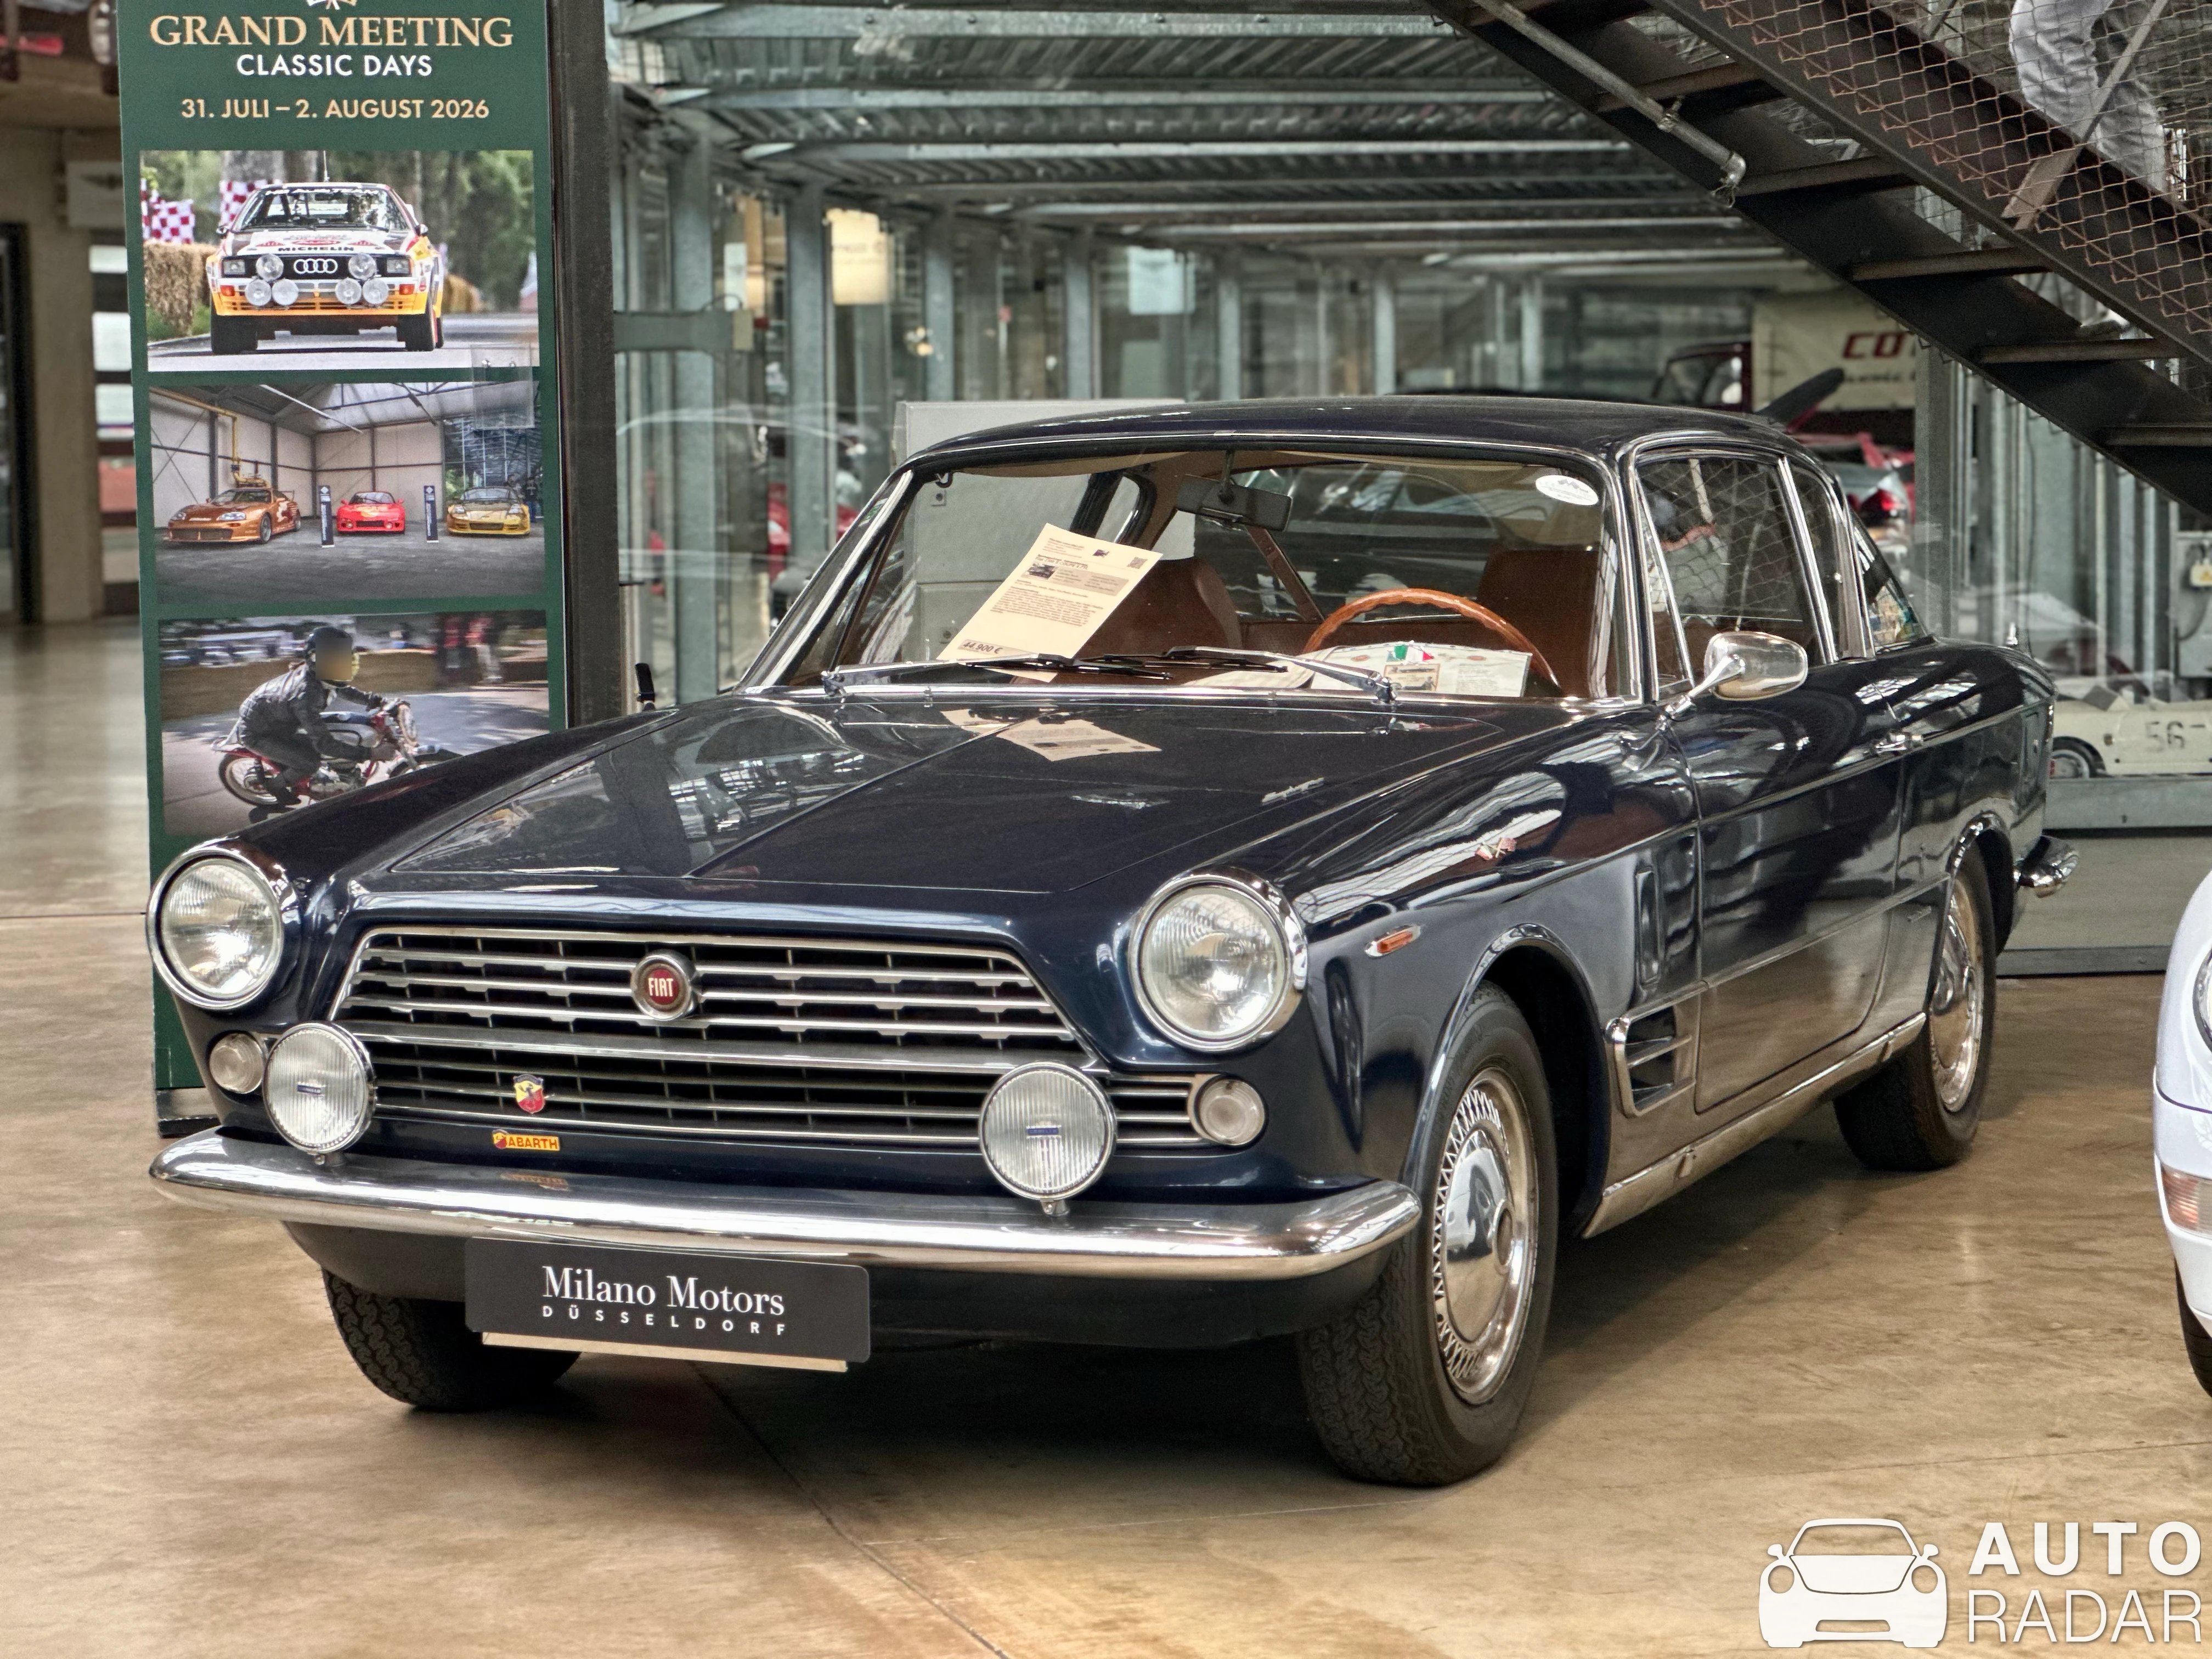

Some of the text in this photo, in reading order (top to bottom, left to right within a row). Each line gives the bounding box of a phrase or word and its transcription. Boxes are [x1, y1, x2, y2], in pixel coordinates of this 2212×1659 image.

[150, 15, 514, 47] GRAND MEETING
[236, 54, 432, 76] CLASSIC DAYS
[182, 99, 215, 119] 31.
[221, 99, 270, 119] JULI
[295, 99, 318, 119] 2.
[325, 99, 424, 119] AUGUST
[431, 99, 490, 119] 2026
[648, 977, 674, 997] FIAT
[509, 1136, 558, 1150] ABARTH
[542, 1266, 785, 1316] Milano Motors
[542, 1305, 786, 1336] DÜSSELDORF
